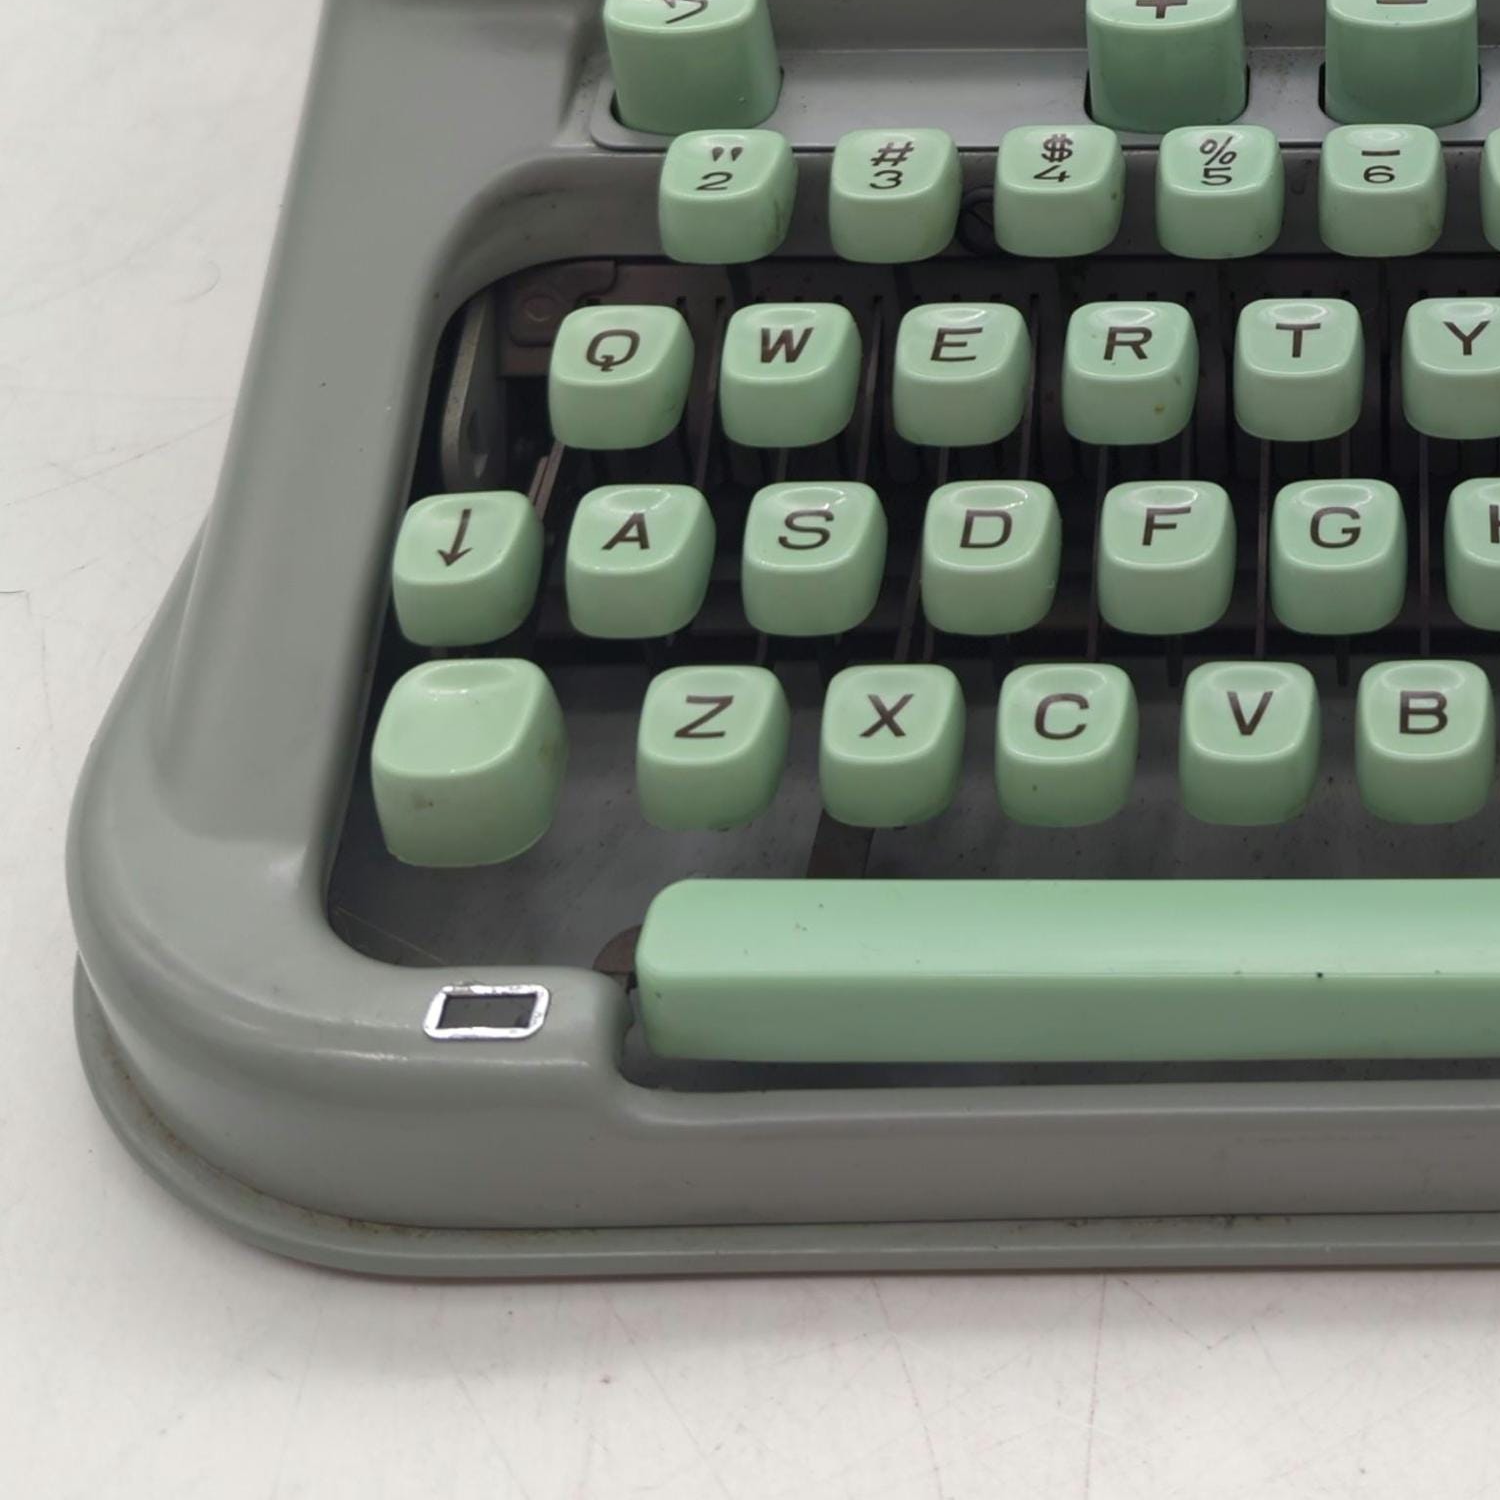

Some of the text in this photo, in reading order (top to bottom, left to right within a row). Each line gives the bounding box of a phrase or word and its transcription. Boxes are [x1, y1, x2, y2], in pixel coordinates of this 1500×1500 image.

[695, 171, 733, 191] 2
[869, 169, 904, 190] 3
[1033, 164, 1071, 183] 4
[1201, 167, 1233, 187] 5
[1363, 165, 1396, 184] 6
[585, 329, 641, 373] Q
[760, 327, 814, 364] W
[930, 326, 984, 363] E
[1103, 326, 1153, 361] R
[1275, 322, 1322, 359] T
[1443, 320, 1491, 357] Y
[601, 513, 650, 551] A
[777, 509, 835, 551] S
[959, 509, 1013, 549] D
[1141, 506, 1192, 547] F
[1309, 506, 1362, 549] G
[674, 695, 734, 740] Z
[859, 693, 914, 738] X
[1034, 693, 1090, 741] C
[1227, 691, 1274, 737] V
[1399, 691, 1449, 736] B
